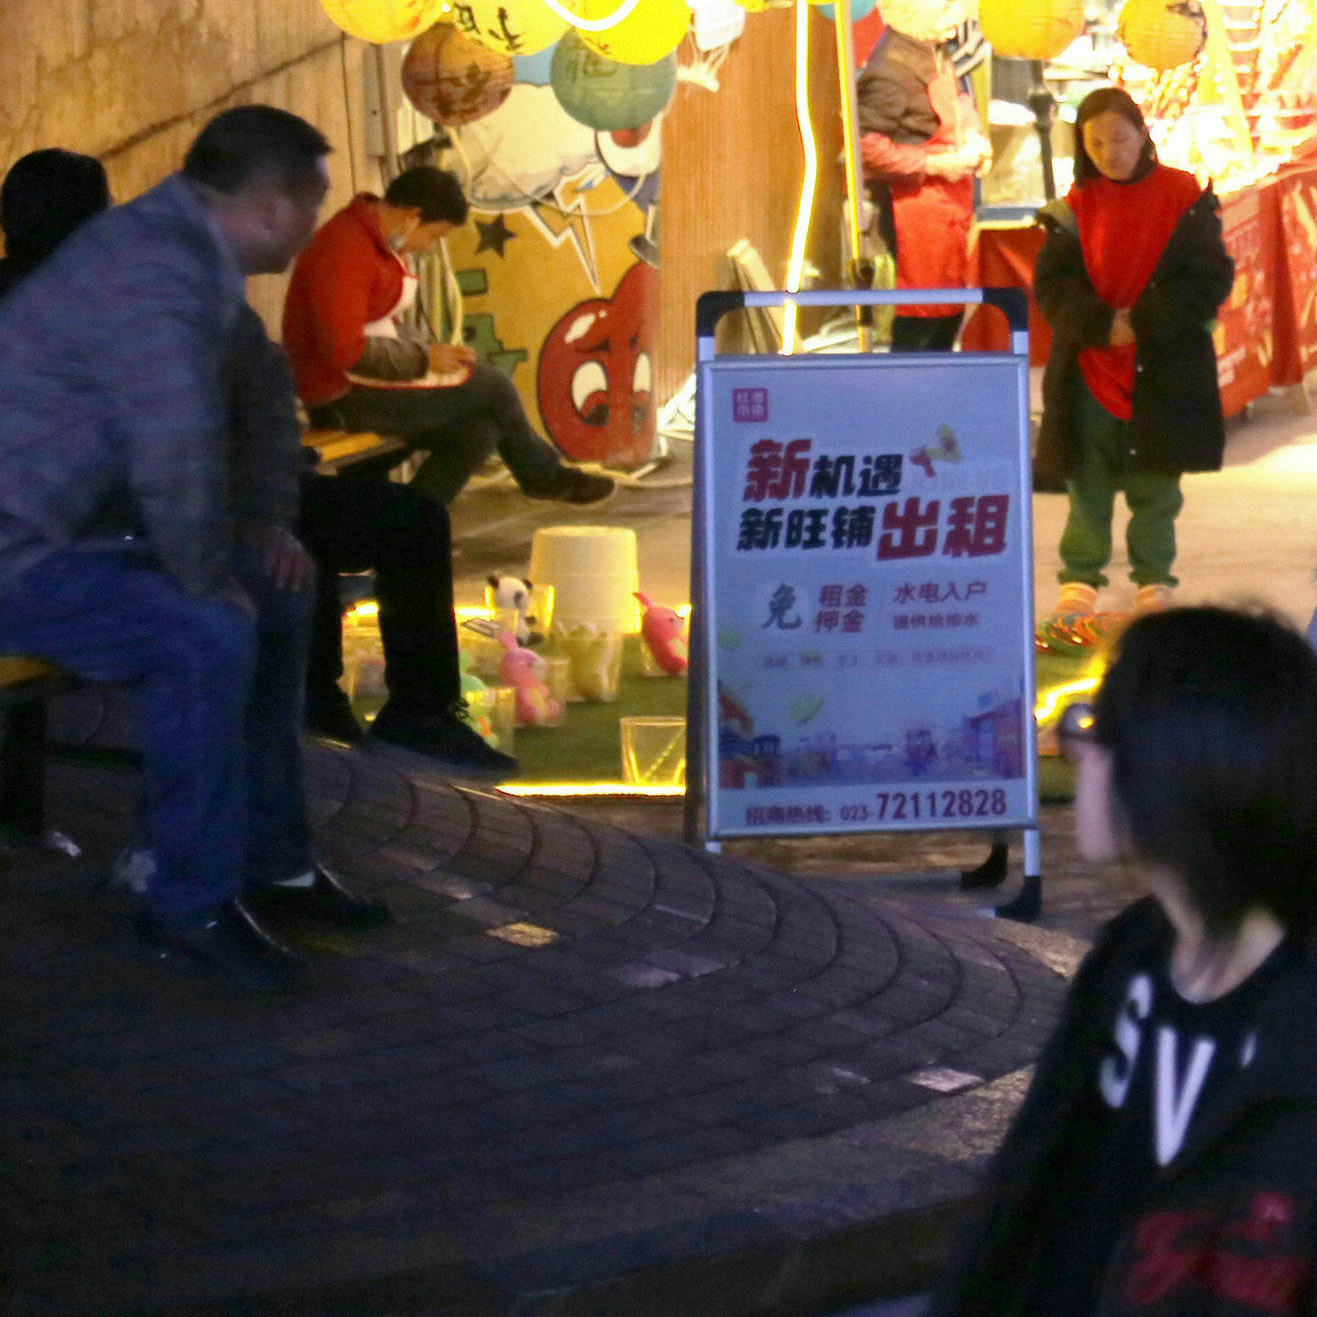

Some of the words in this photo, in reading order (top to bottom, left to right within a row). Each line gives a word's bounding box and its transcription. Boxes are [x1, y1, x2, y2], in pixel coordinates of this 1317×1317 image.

[743, 438, 903, 502] 新机遇
[736, 495, 1010, 562] 新旺铺出租
[893, 580, 988, 604] 水电入户
